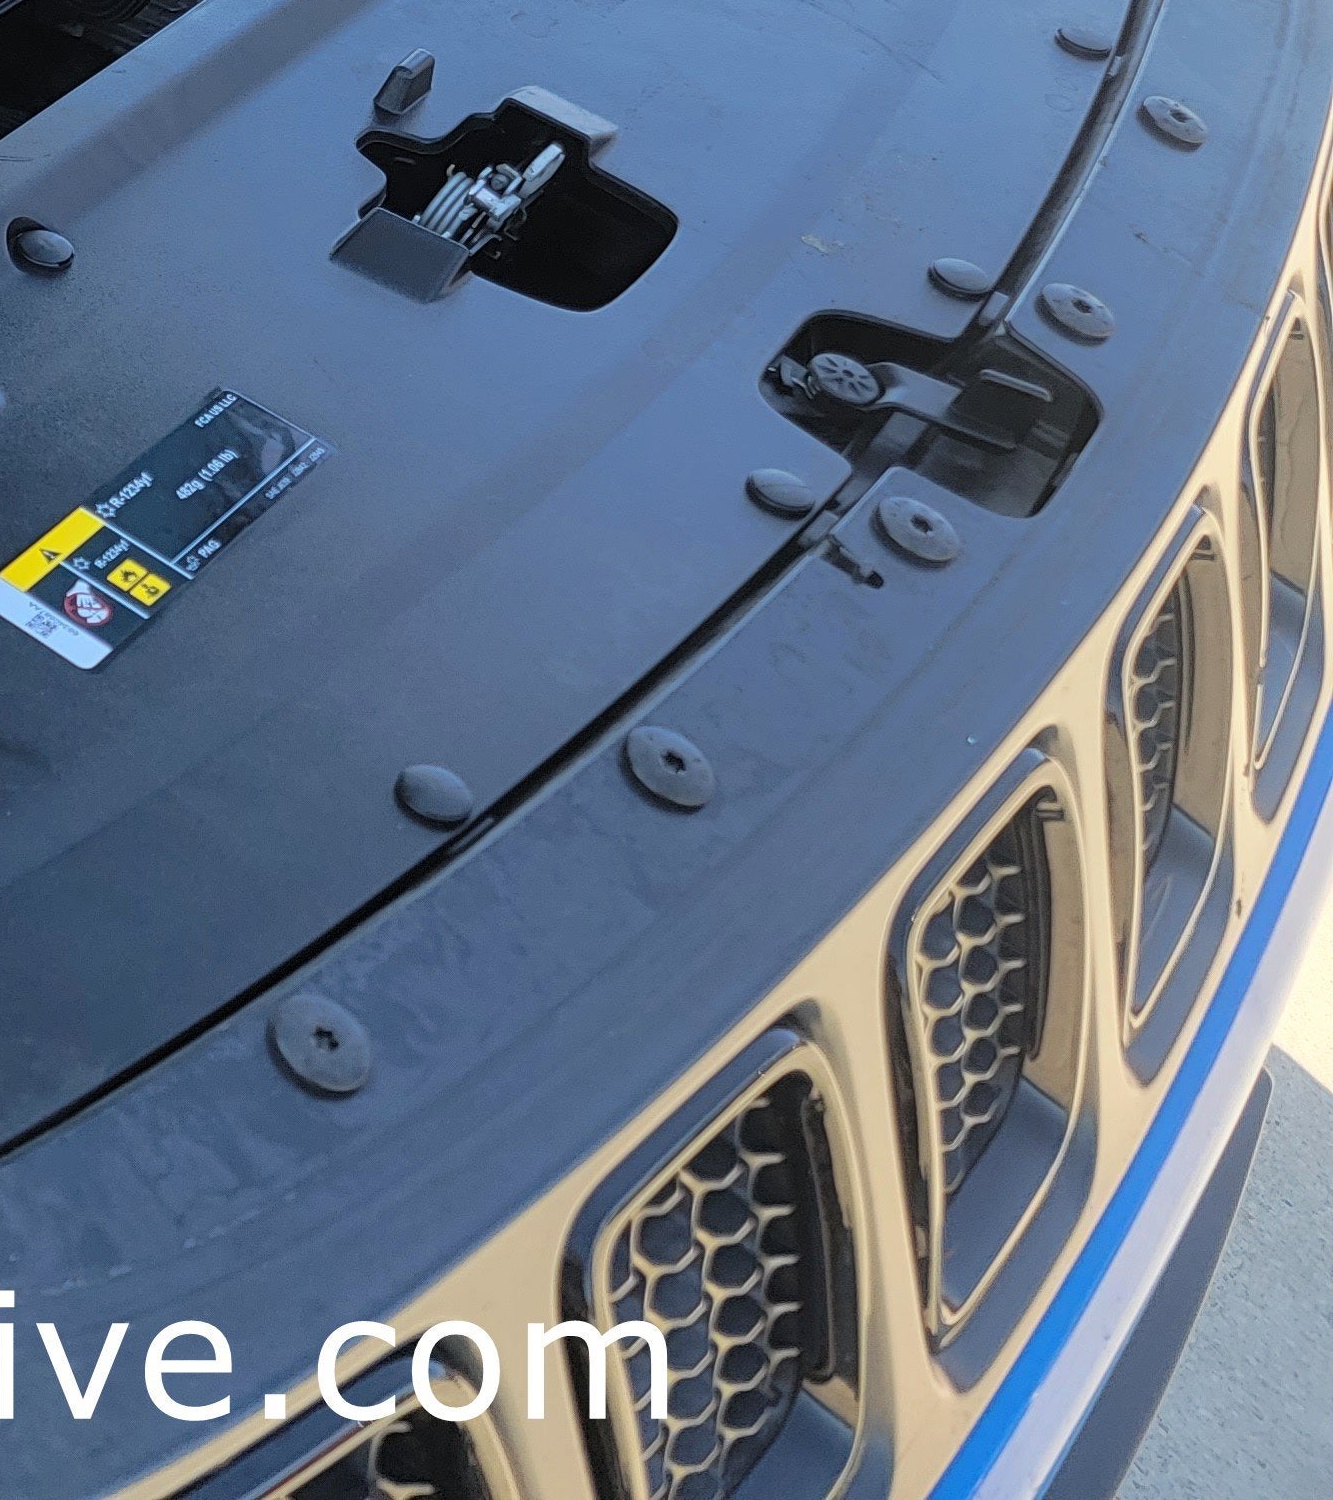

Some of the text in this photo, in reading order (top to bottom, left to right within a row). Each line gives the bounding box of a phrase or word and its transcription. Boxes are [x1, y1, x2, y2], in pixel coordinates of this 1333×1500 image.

[194, 410, 213, 428] FCA
[221, 392, 238, 410] LLC
[198, 457, 226, 483] (1.06
[219, 448, 239, 468] lb)
[110, 470, 155, 510] R-1234yf
[197, 537, 223, 560] PAG
